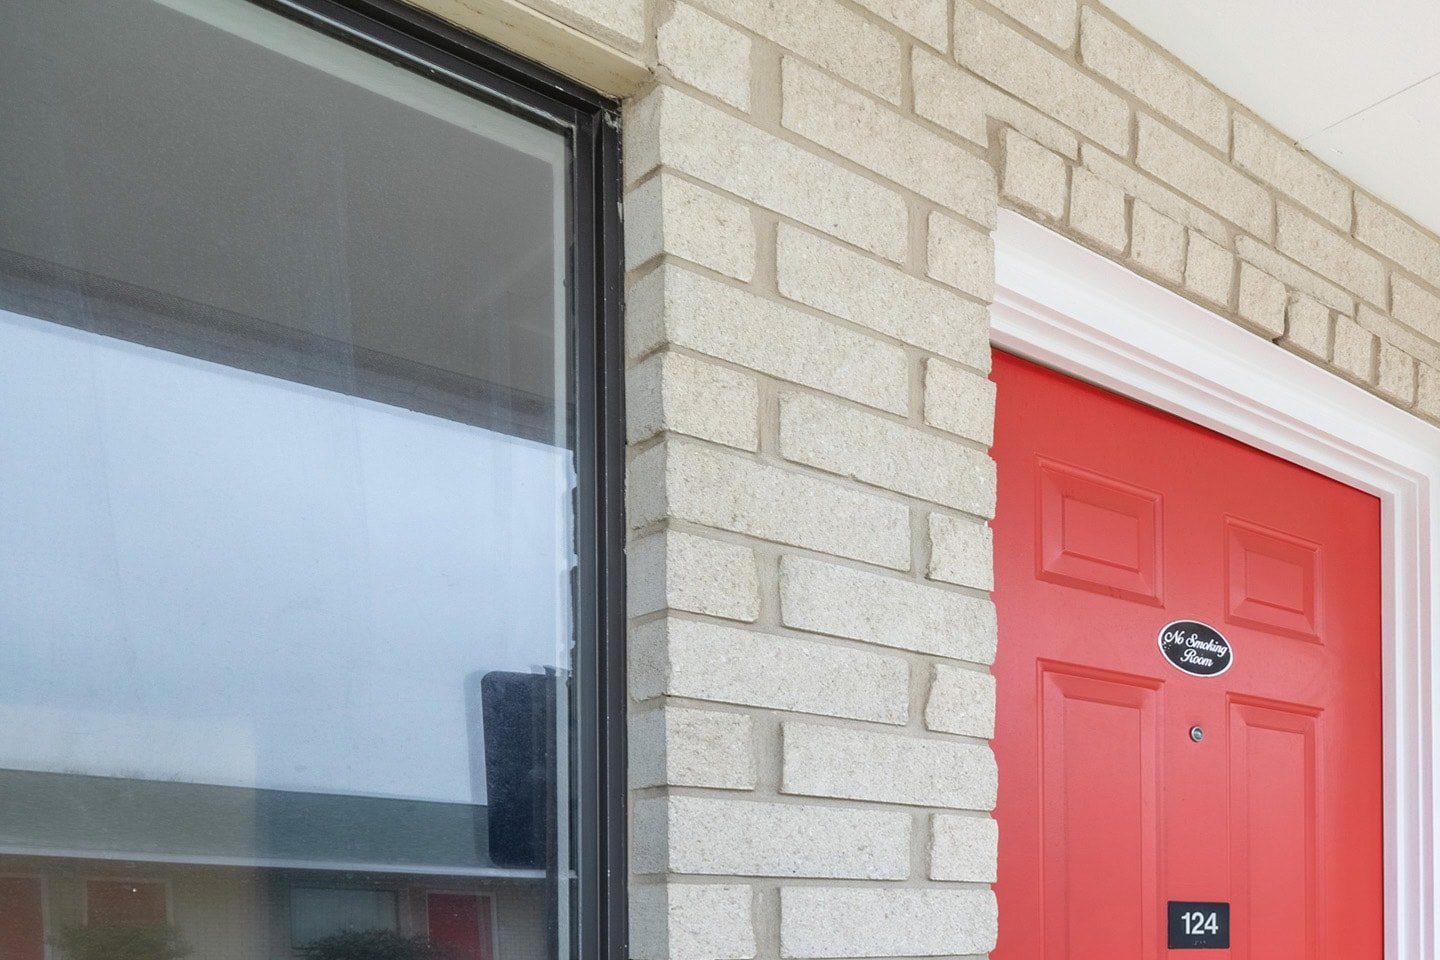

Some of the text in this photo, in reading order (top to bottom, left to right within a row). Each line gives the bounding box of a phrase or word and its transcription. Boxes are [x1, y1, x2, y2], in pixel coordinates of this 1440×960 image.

[1164, 630, 1228, 658] No Smoking
[1180, 648, 1214, 667] Room
[1181, 911, 1219, 935] 124
